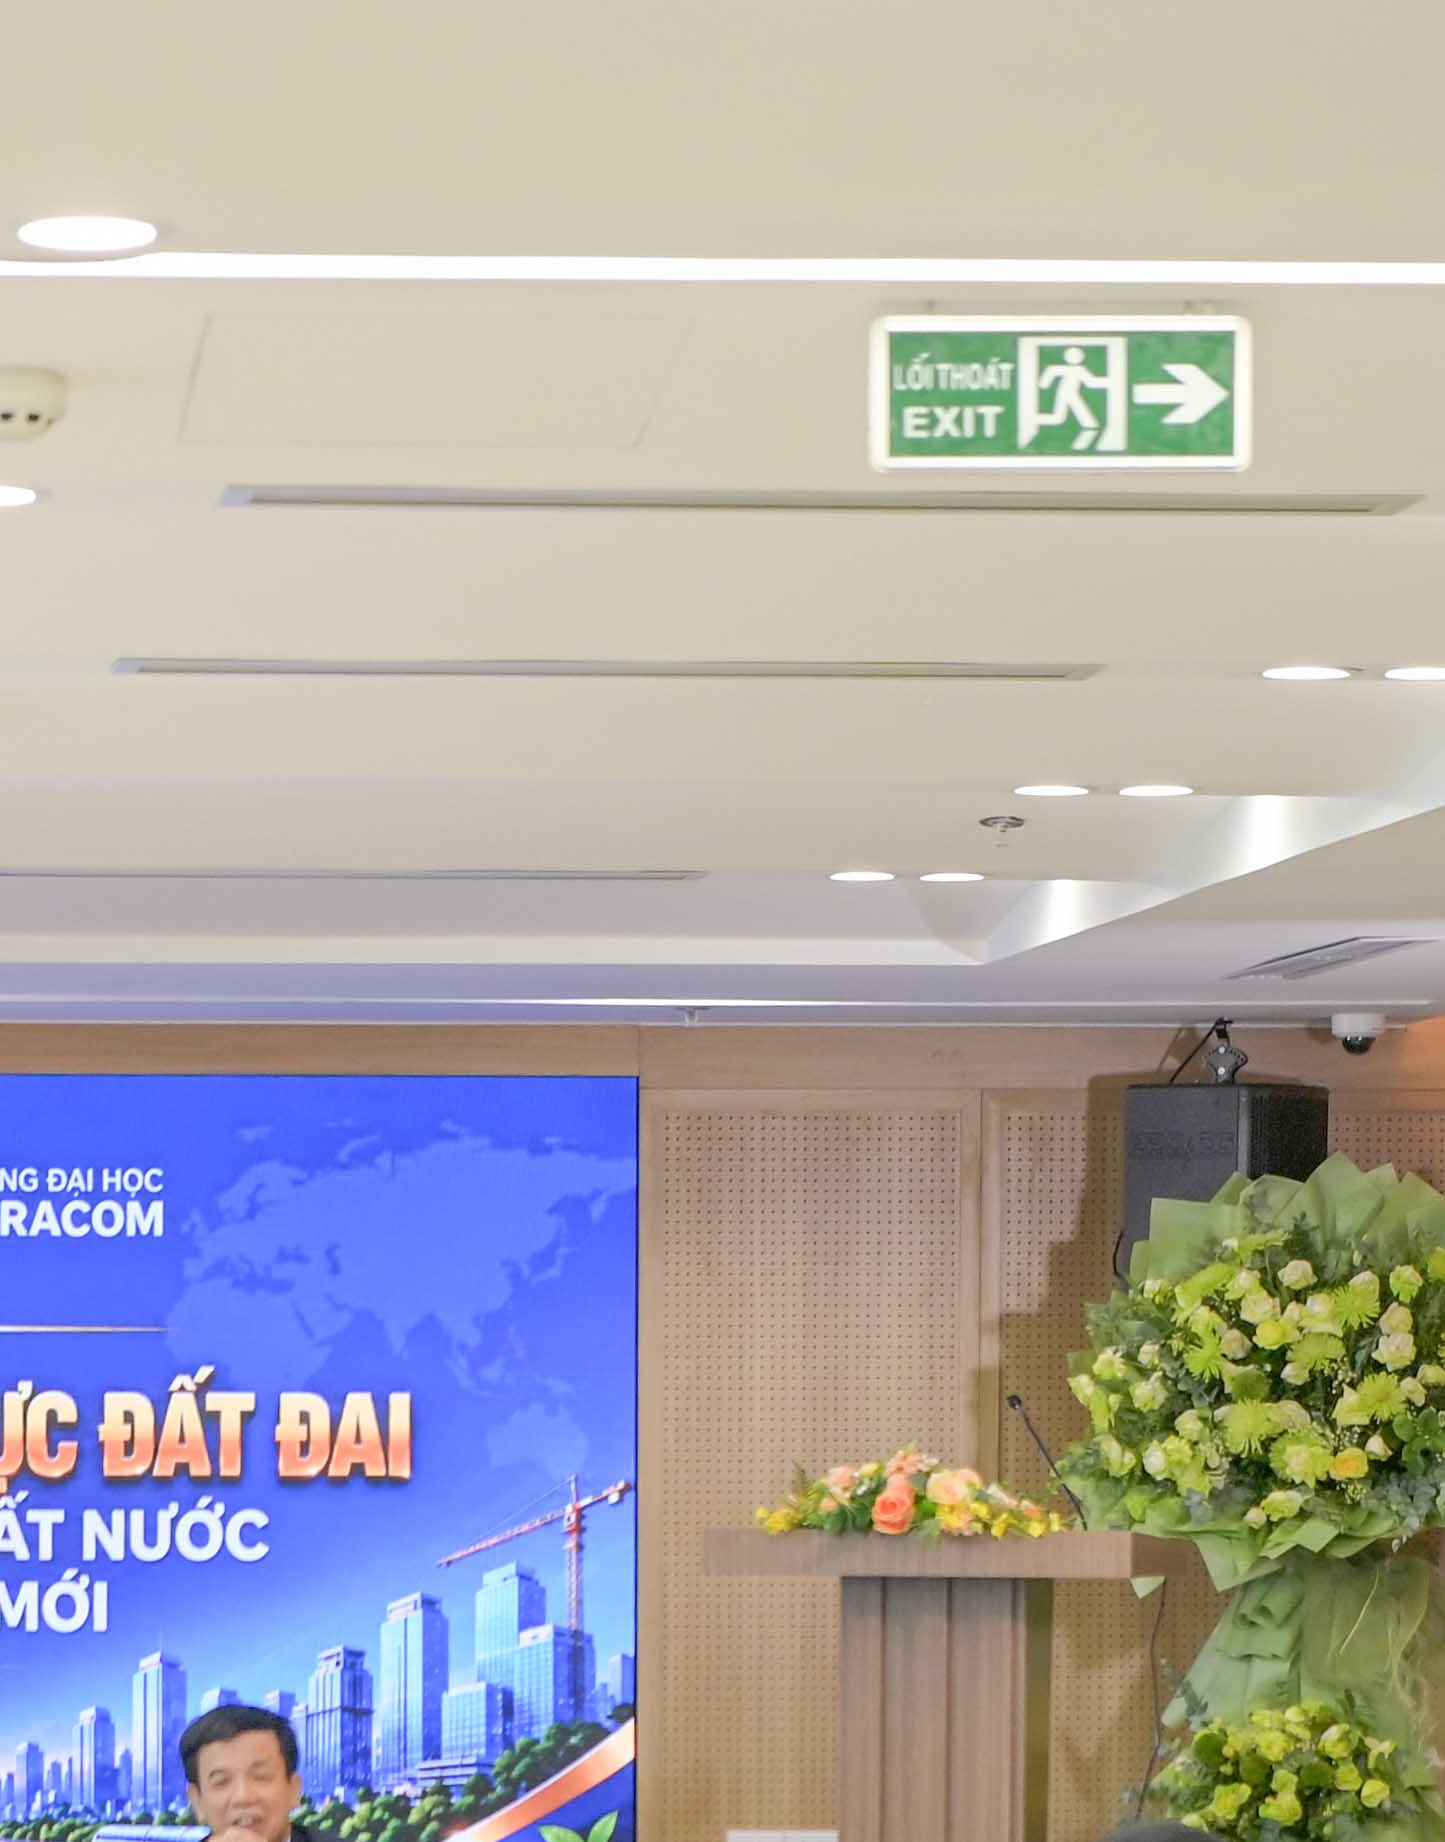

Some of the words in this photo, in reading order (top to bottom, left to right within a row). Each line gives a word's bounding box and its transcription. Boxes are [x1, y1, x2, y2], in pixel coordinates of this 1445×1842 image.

[936, 356, 1015, 391] THOÁT
[903, 406, 1005, 438] EXIT
[46, 1166, 94, 1197] ĐẠI
[102, 1166, 164, 1199] HỌC
[98, 1366, 256, 1479] ĐẤT
[275, 1390, 411, 1480] ĐAI
[82, 1496, 270, 1562] NƯỚC
